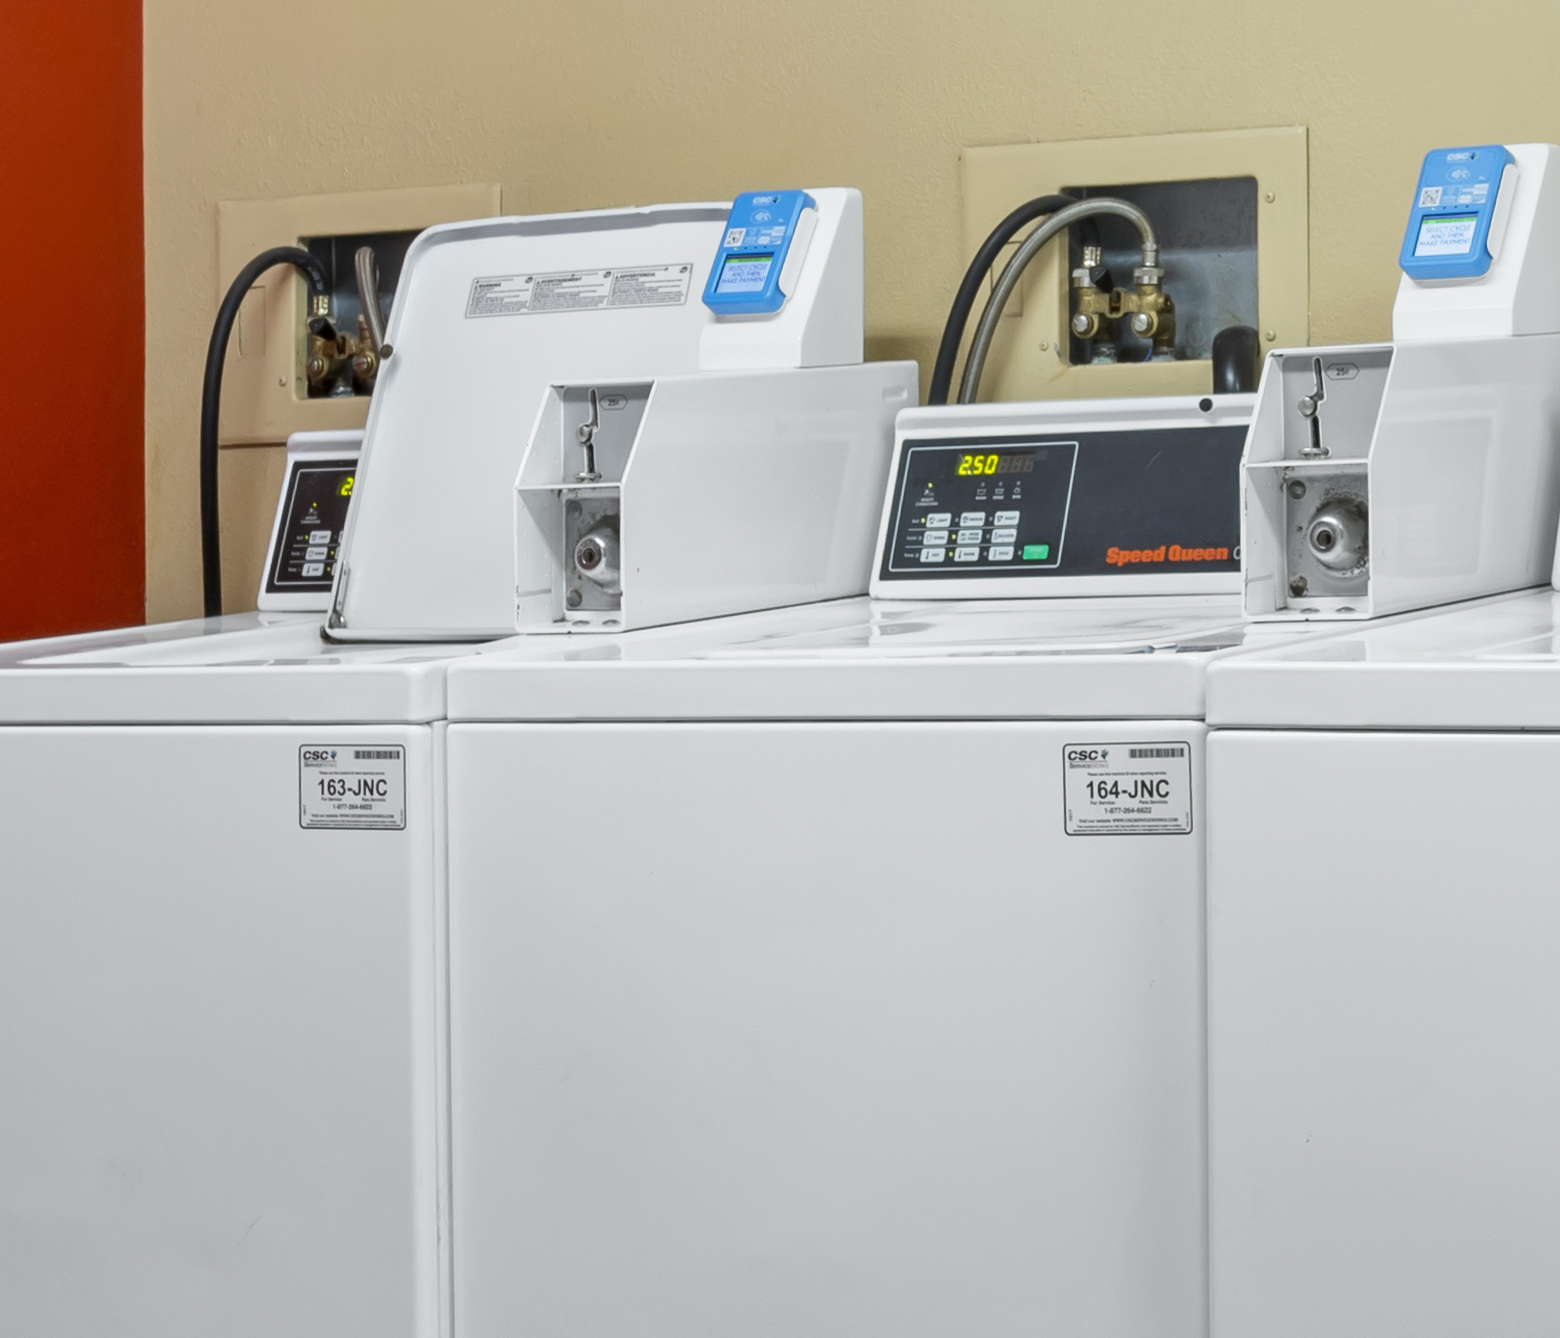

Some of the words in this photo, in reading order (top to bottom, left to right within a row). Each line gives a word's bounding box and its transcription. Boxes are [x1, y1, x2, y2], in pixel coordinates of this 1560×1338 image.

[1106, 545, 1166, 567] Speed
[1168, 545, 1228, 561] Queen
[303, 750, 329, 761] CSC
[1068, 750, 1099, 761] CSC
[318, 779, 388, 796] 163-JNC
[1086, 779, 1170, 799] 164-JNC
